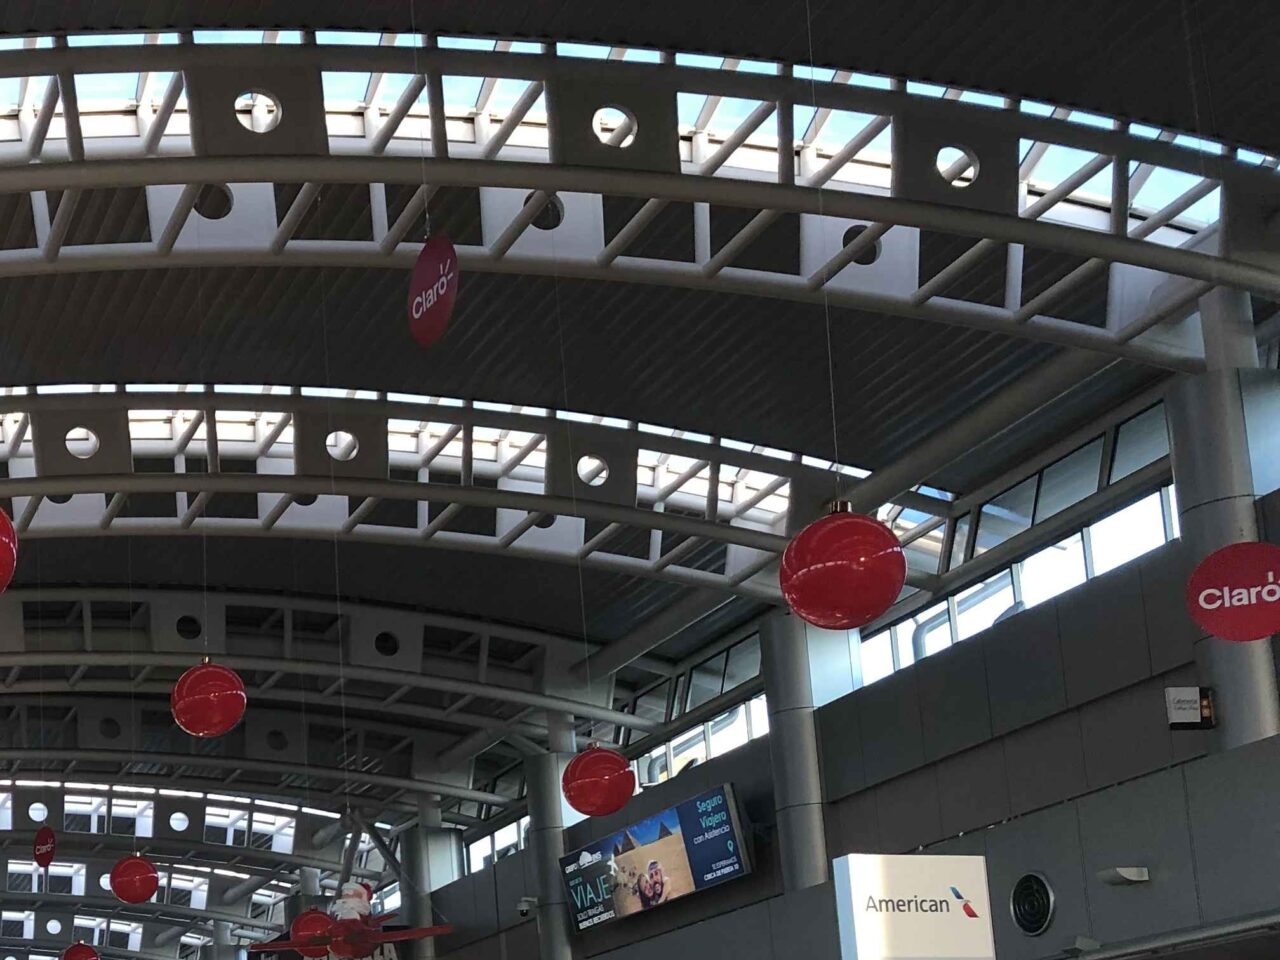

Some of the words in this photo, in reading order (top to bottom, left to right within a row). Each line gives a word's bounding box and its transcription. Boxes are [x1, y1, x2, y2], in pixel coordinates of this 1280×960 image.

[412, 275, 447, 319] Claro
[1198, 583, 1280, 610] Claro
[696, 795, 723, 813] Seguro
[699, 811, 727, 828] Viajero
[570, 874, 612, 909] VIAJE
[866, 894, 950, 913] American
